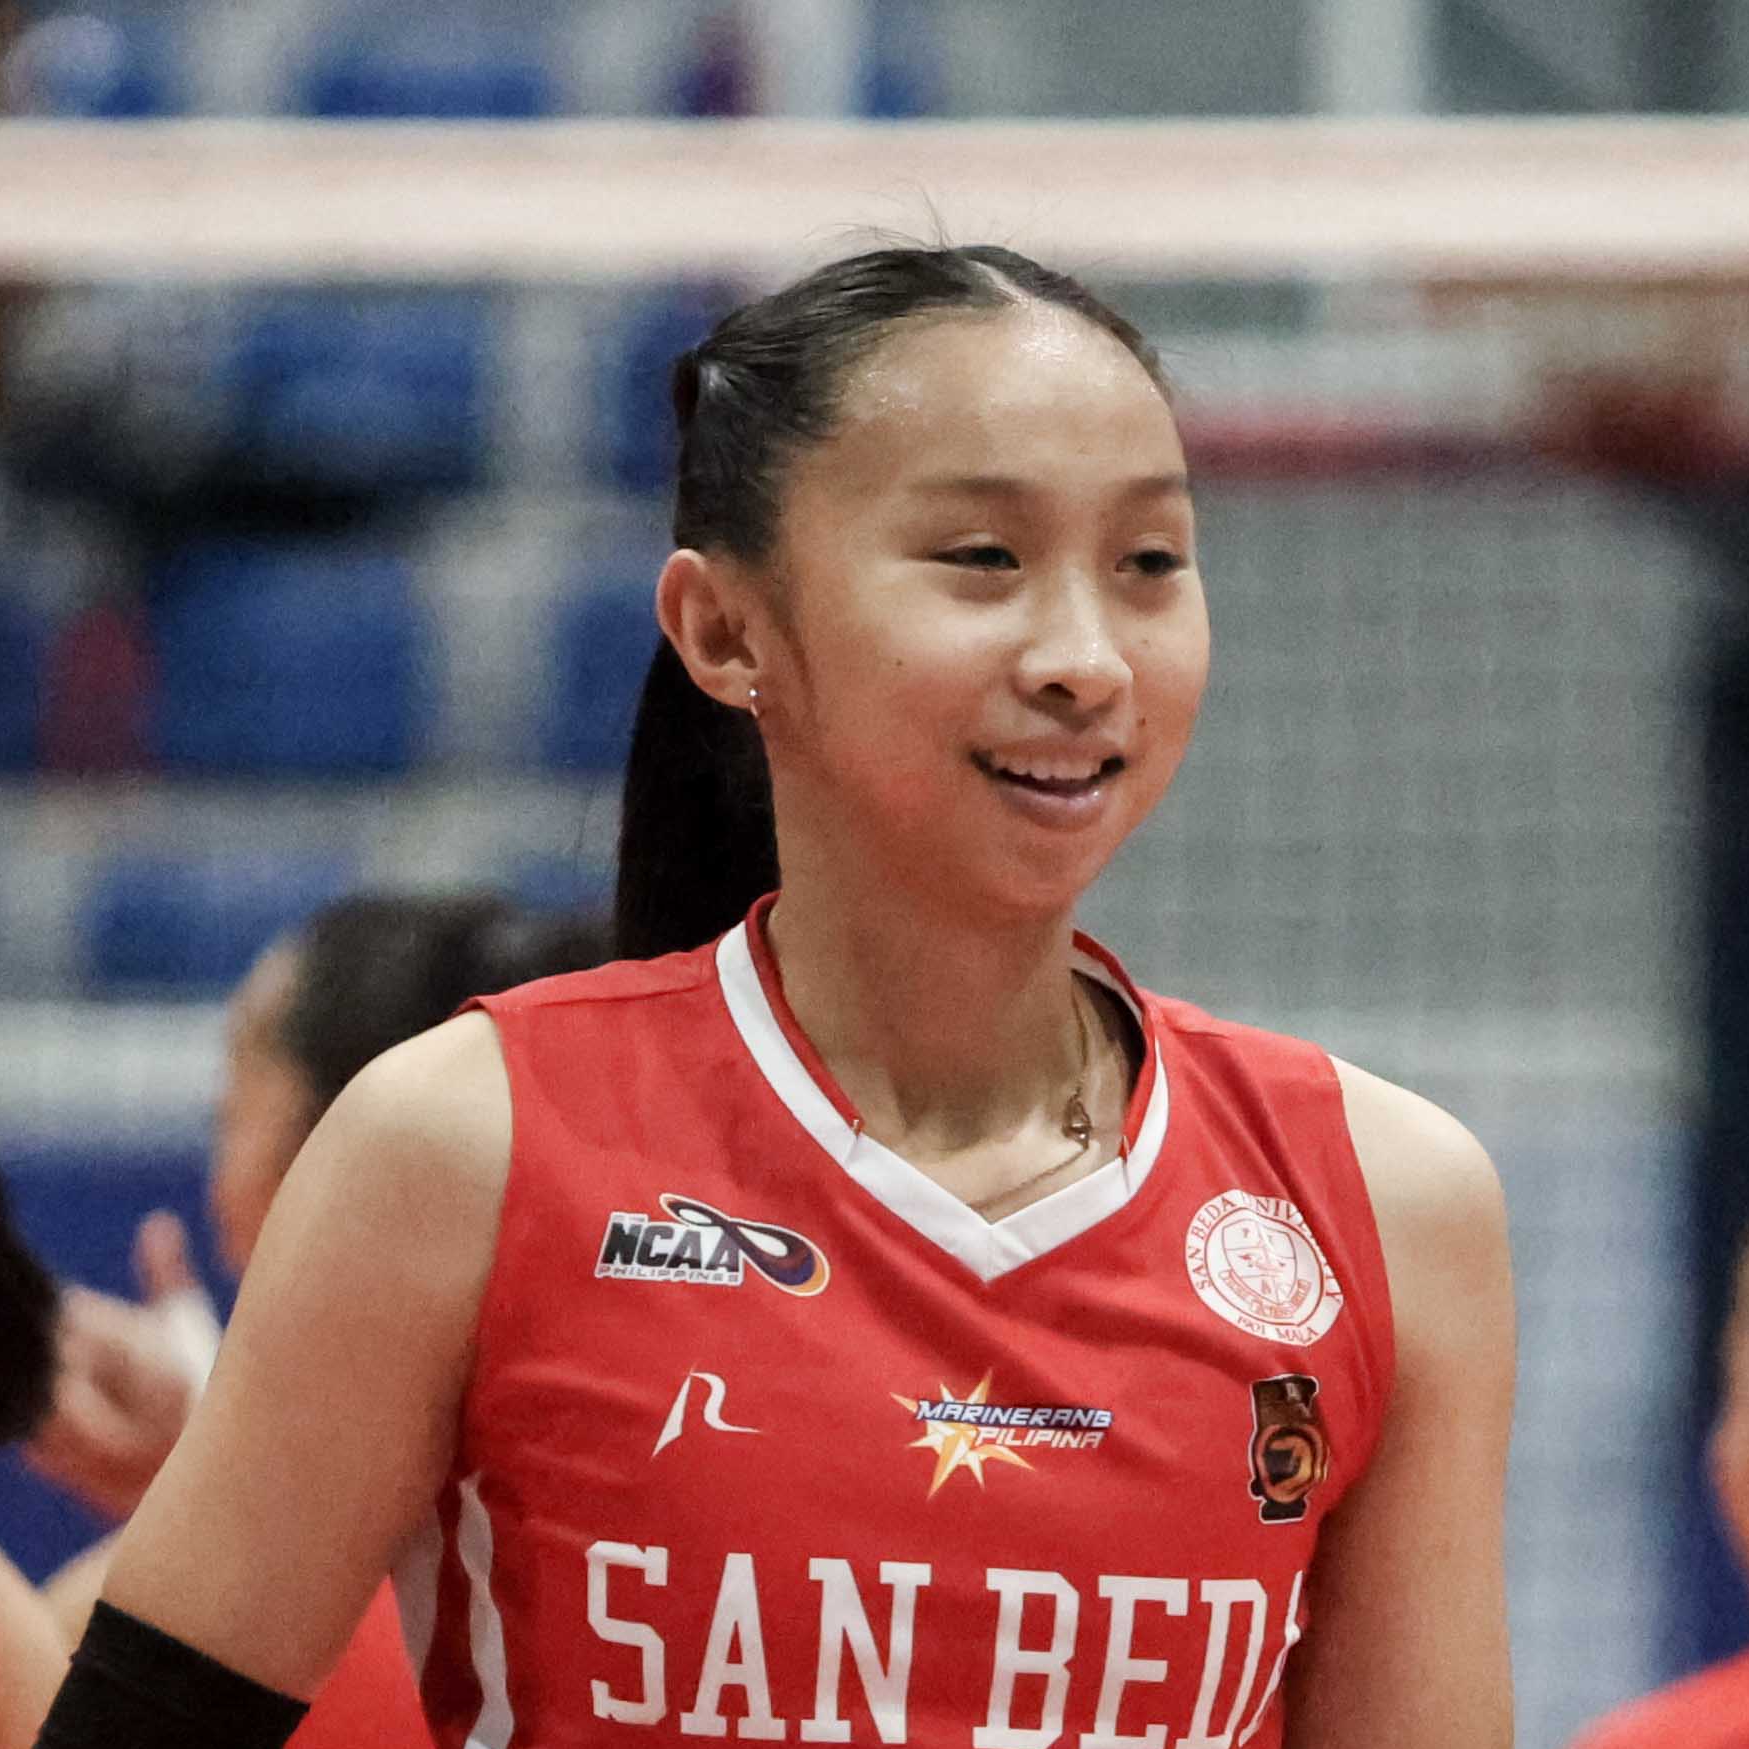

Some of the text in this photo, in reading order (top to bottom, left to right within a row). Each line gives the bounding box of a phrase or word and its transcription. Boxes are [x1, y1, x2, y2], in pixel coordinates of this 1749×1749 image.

[601, 1222, 741, 1272] NCAA
[598, 1266, 739, 1283] PHILIPPINES
[916, 1400, 1112, 1428] MARINERANG
[975, 1426, 1104, 1449] PILIPINA
[587, 1539, 932, 1744] SAN
